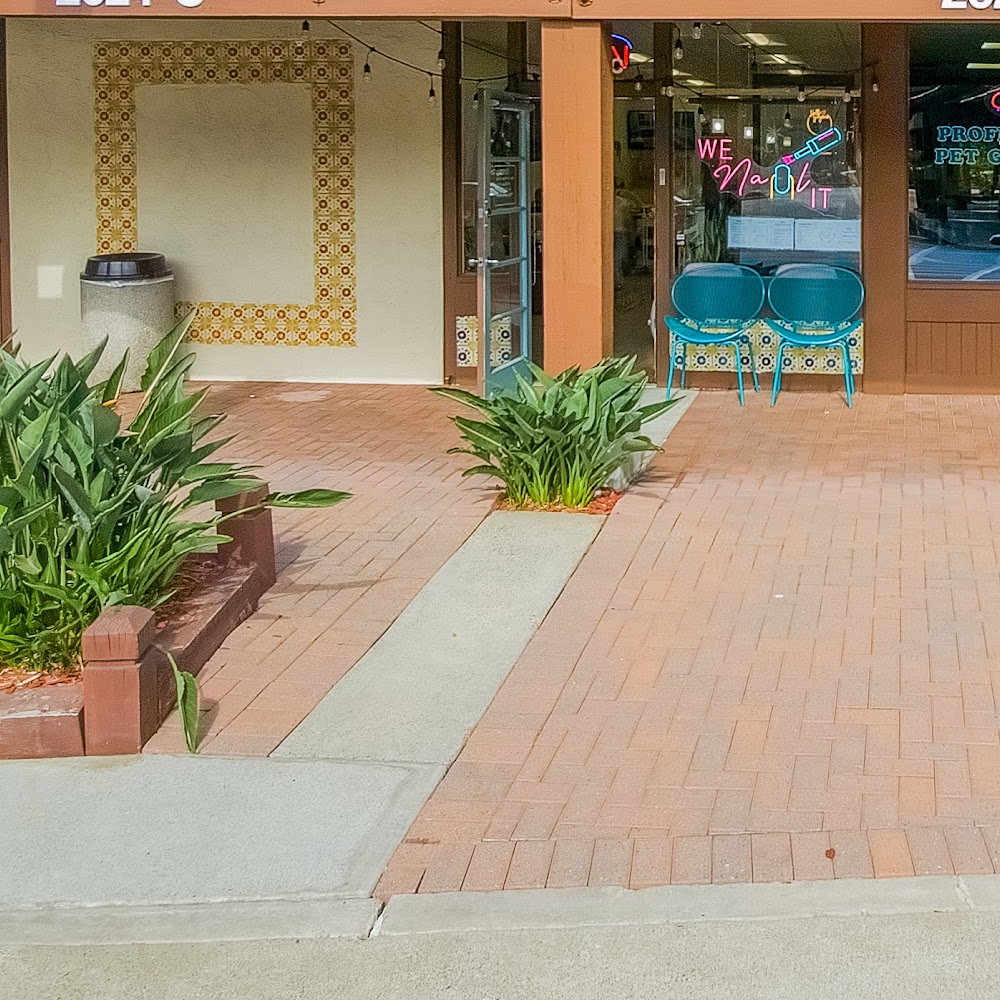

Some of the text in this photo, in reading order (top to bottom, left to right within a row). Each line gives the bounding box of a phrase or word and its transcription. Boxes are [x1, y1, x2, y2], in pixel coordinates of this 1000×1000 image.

[697, 138, 733, 160] WE
[934, 148, 980, 165] PET
[811, 187, 832, 209] IT
